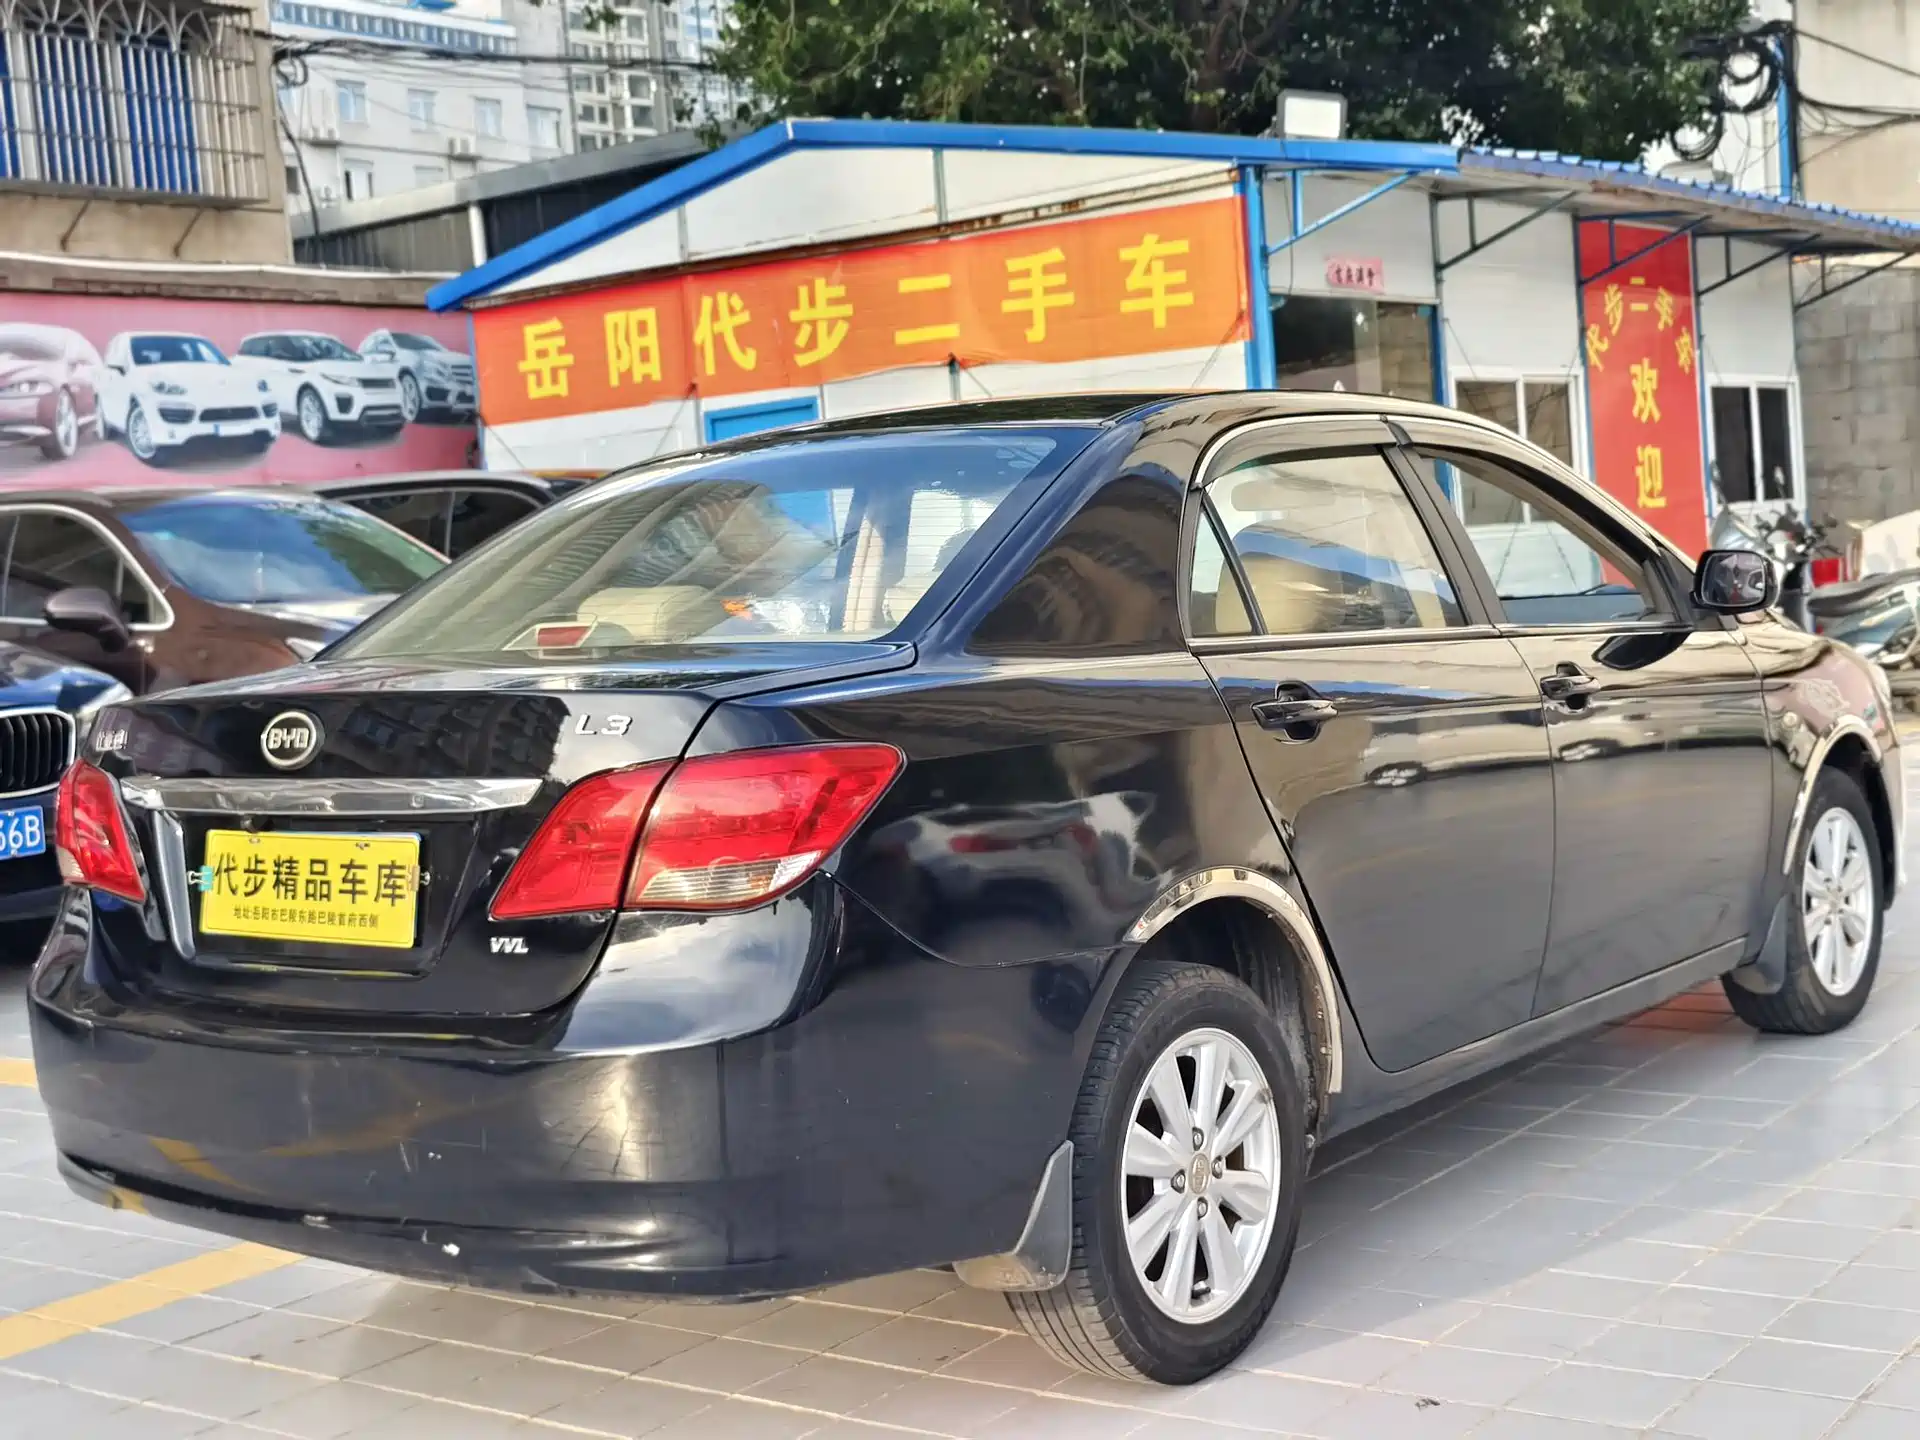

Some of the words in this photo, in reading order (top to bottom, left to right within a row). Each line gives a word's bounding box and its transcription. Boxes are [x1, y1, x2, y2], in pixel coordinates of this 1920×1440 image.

[518, 233, 1194, 399] 岳阳代步二手车
[1630, 357, 1667, 508] 欢迎
[268, 727, 309, 749] BYD
[574, 714, 633, 736] L3
[215, 852, 407, 907] 代步精品车库
[490, 937, 529, 954] VVL
